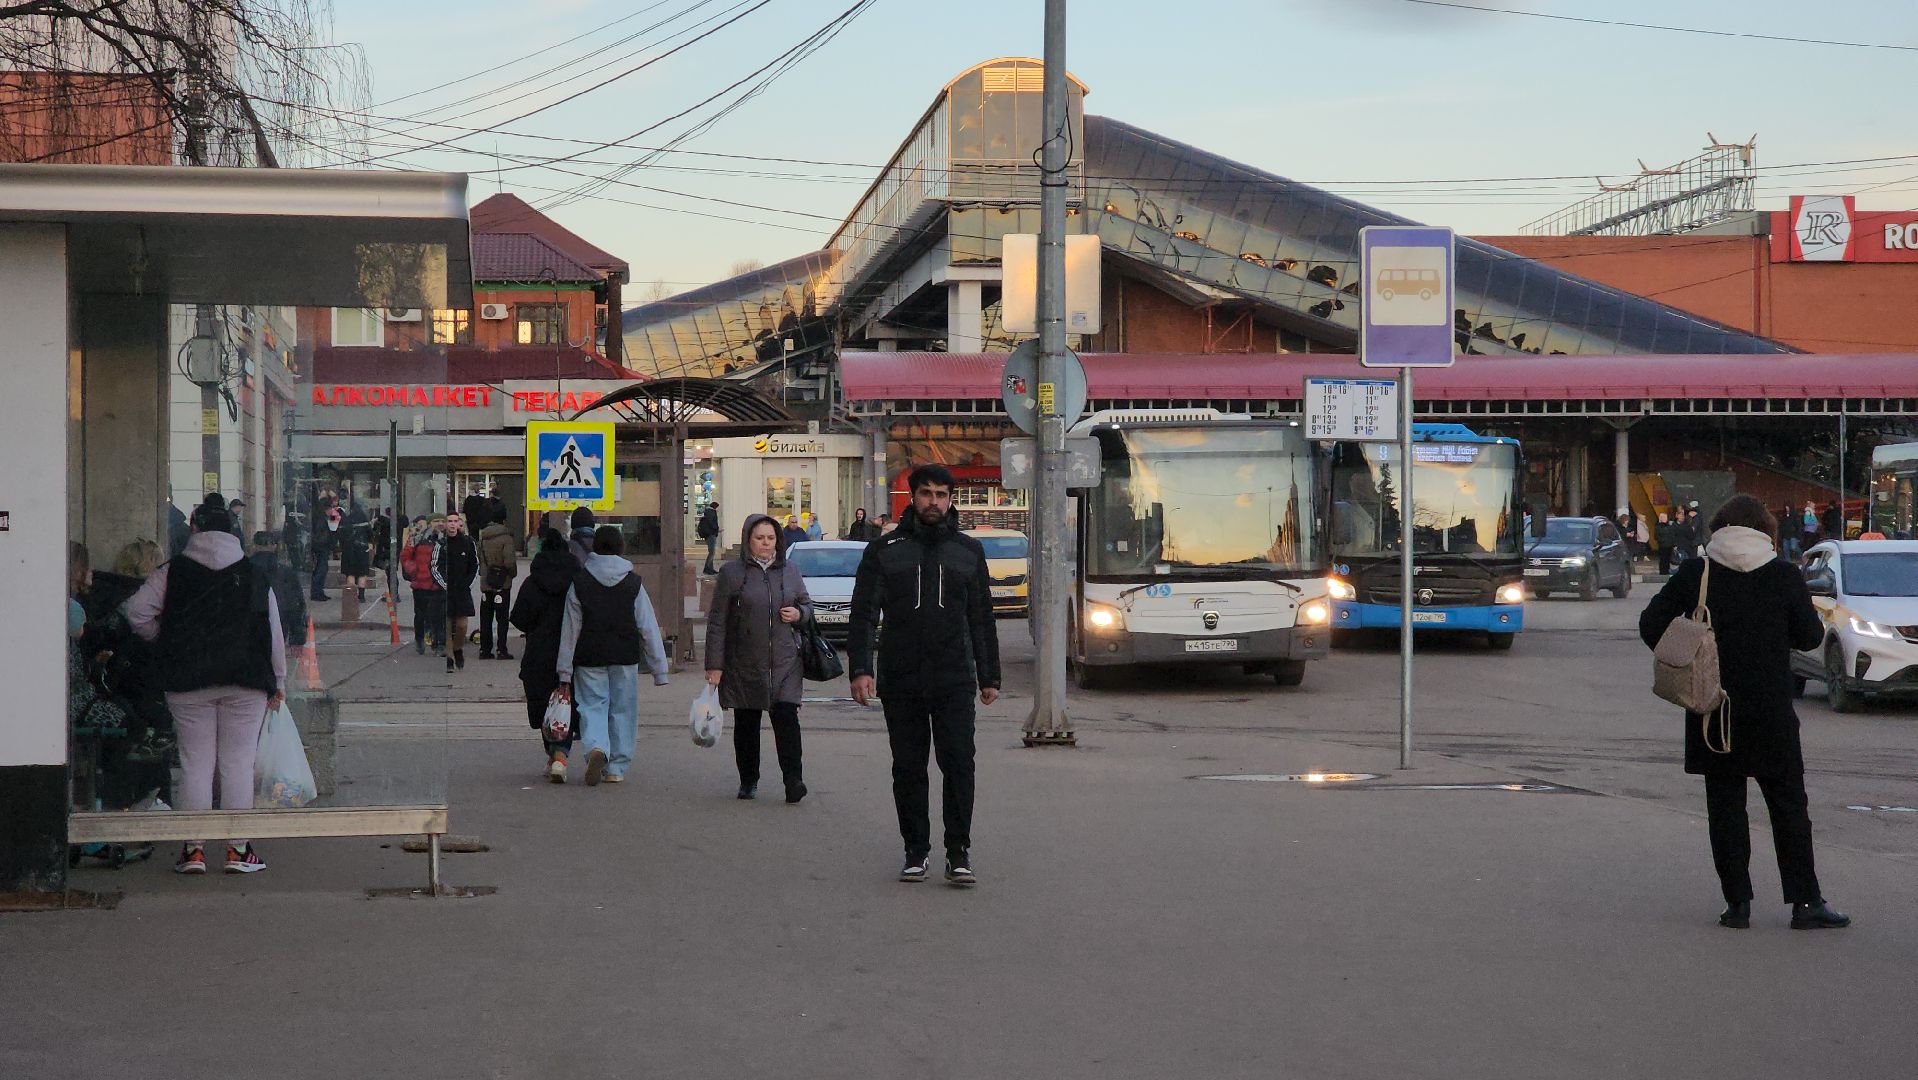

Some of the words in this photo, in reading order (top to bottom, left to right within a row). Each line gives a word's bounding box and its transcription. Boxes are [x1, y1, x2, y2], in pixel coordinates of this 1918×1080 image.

[1884, 222, 1918, 249] RO
[513, 391, 632, 412] ПЕКАР
[770, 440, 824, 453] билайн
